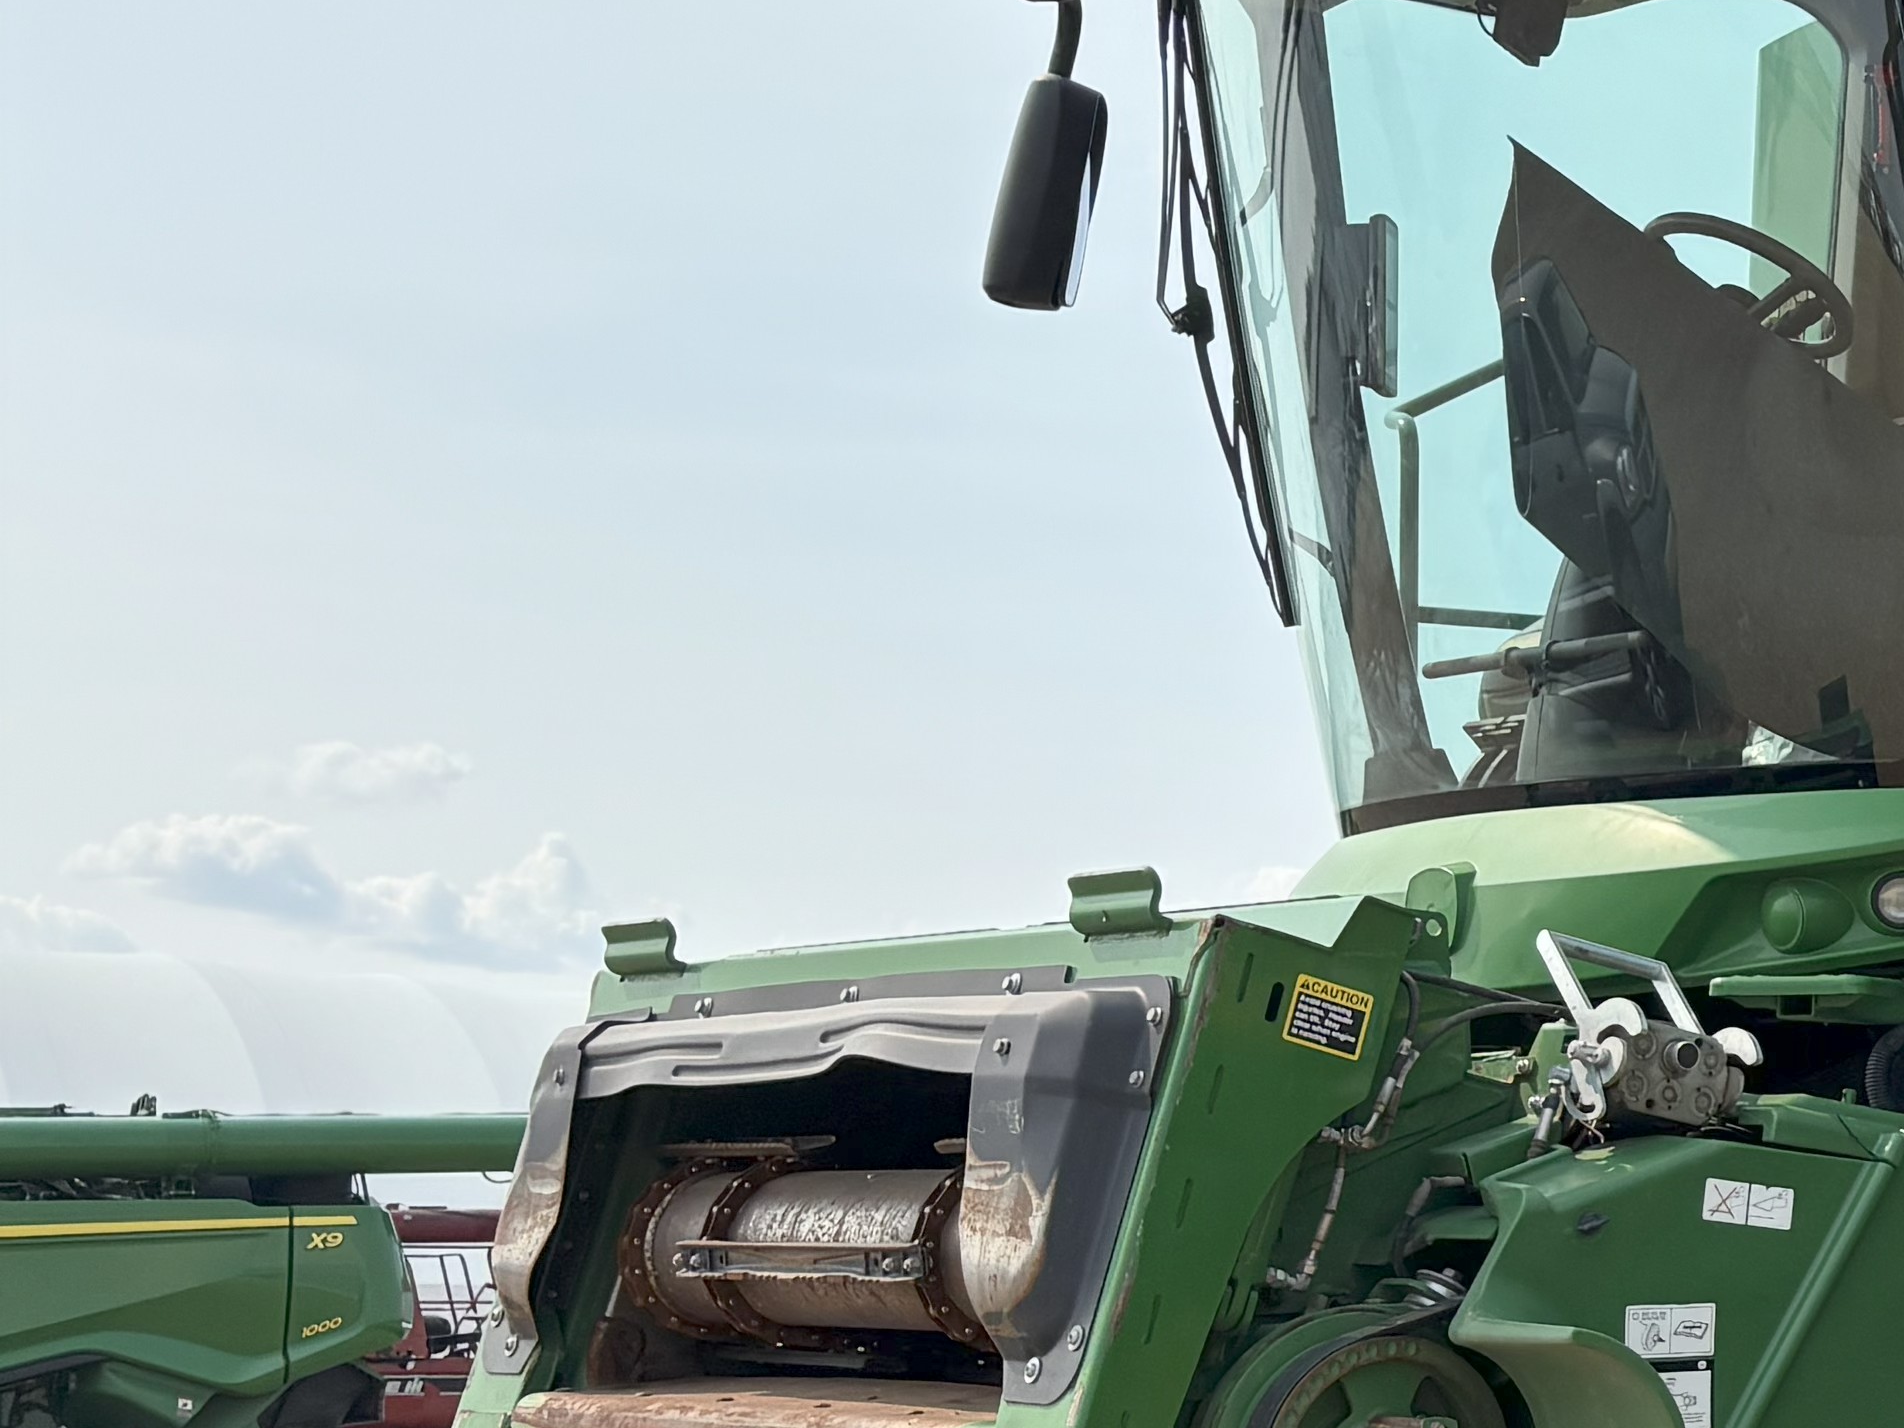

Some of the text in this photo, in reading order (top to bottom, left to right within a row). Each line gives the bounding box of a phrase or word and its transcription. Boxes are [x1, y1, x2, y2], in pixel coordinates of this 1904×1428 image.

[1311, 980, 1370, 1009] CAUTION
[306, 1232, 344, 1250] X9
[301, 1317, 343, 1339] 1000
